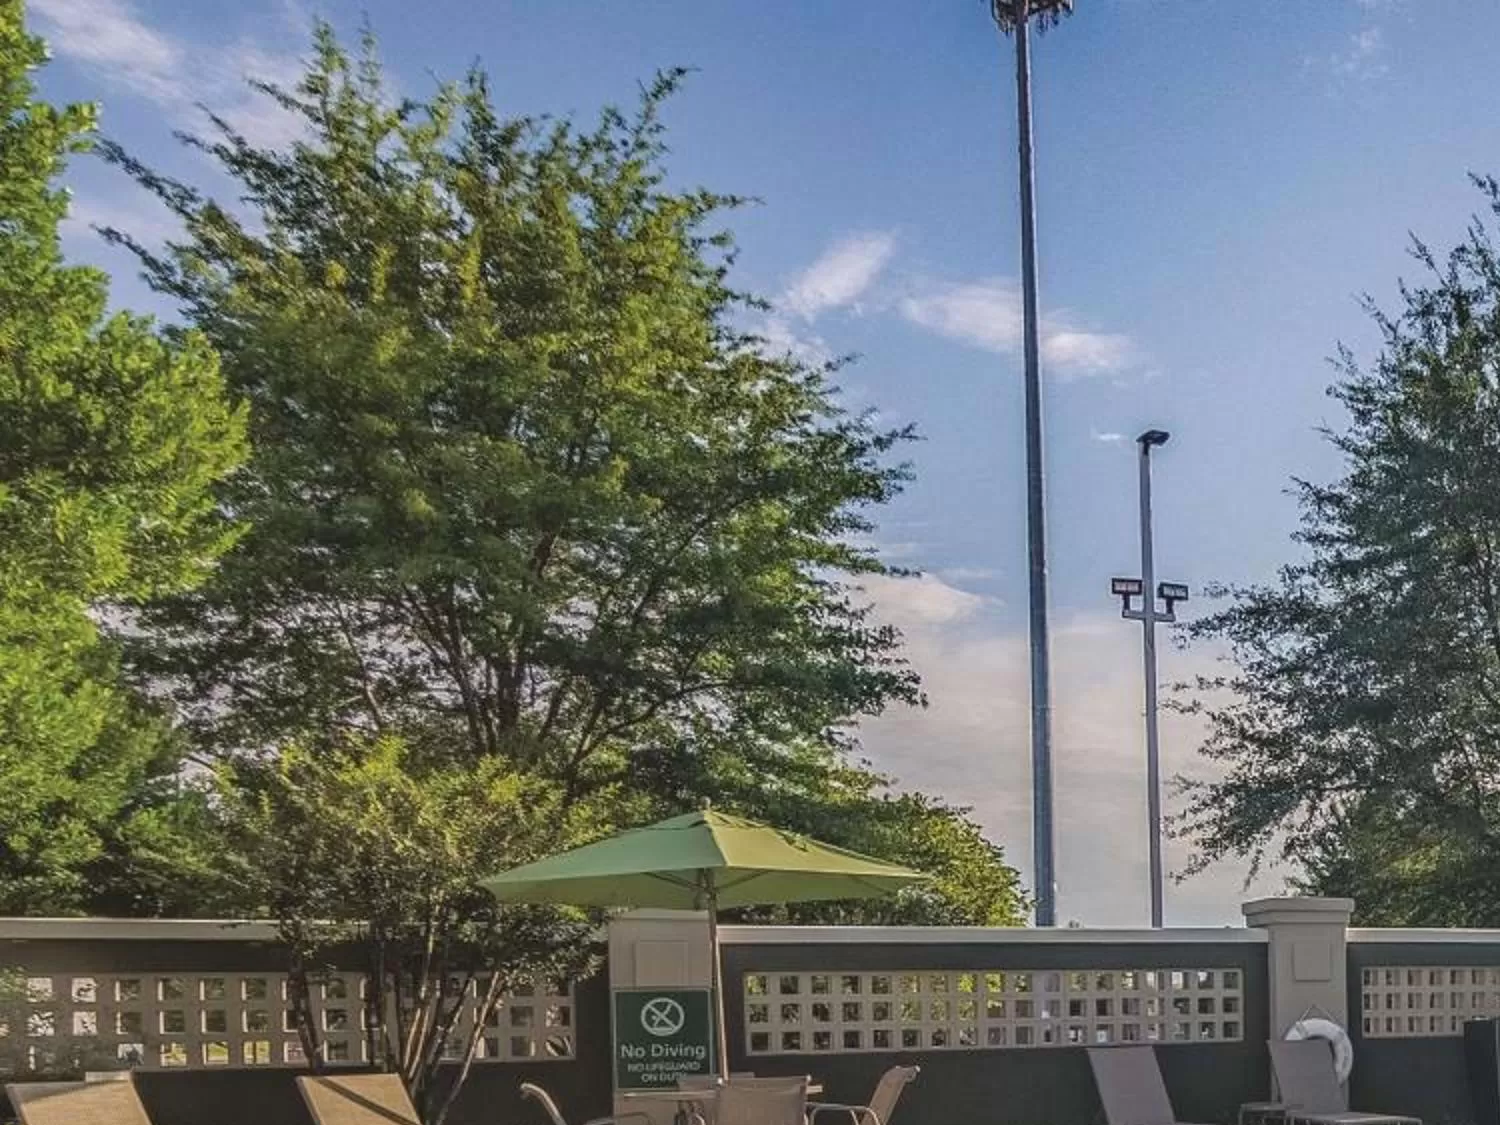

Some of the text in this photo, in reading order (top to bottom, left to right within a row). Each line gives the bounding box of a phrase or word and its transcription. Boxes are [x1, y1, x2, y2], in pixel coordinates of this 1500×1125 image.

[620, 1043, 706, 1060] No Diving
[627, 1063, 644, 1073] NO
[641, 1074, 657, 1083] ON
